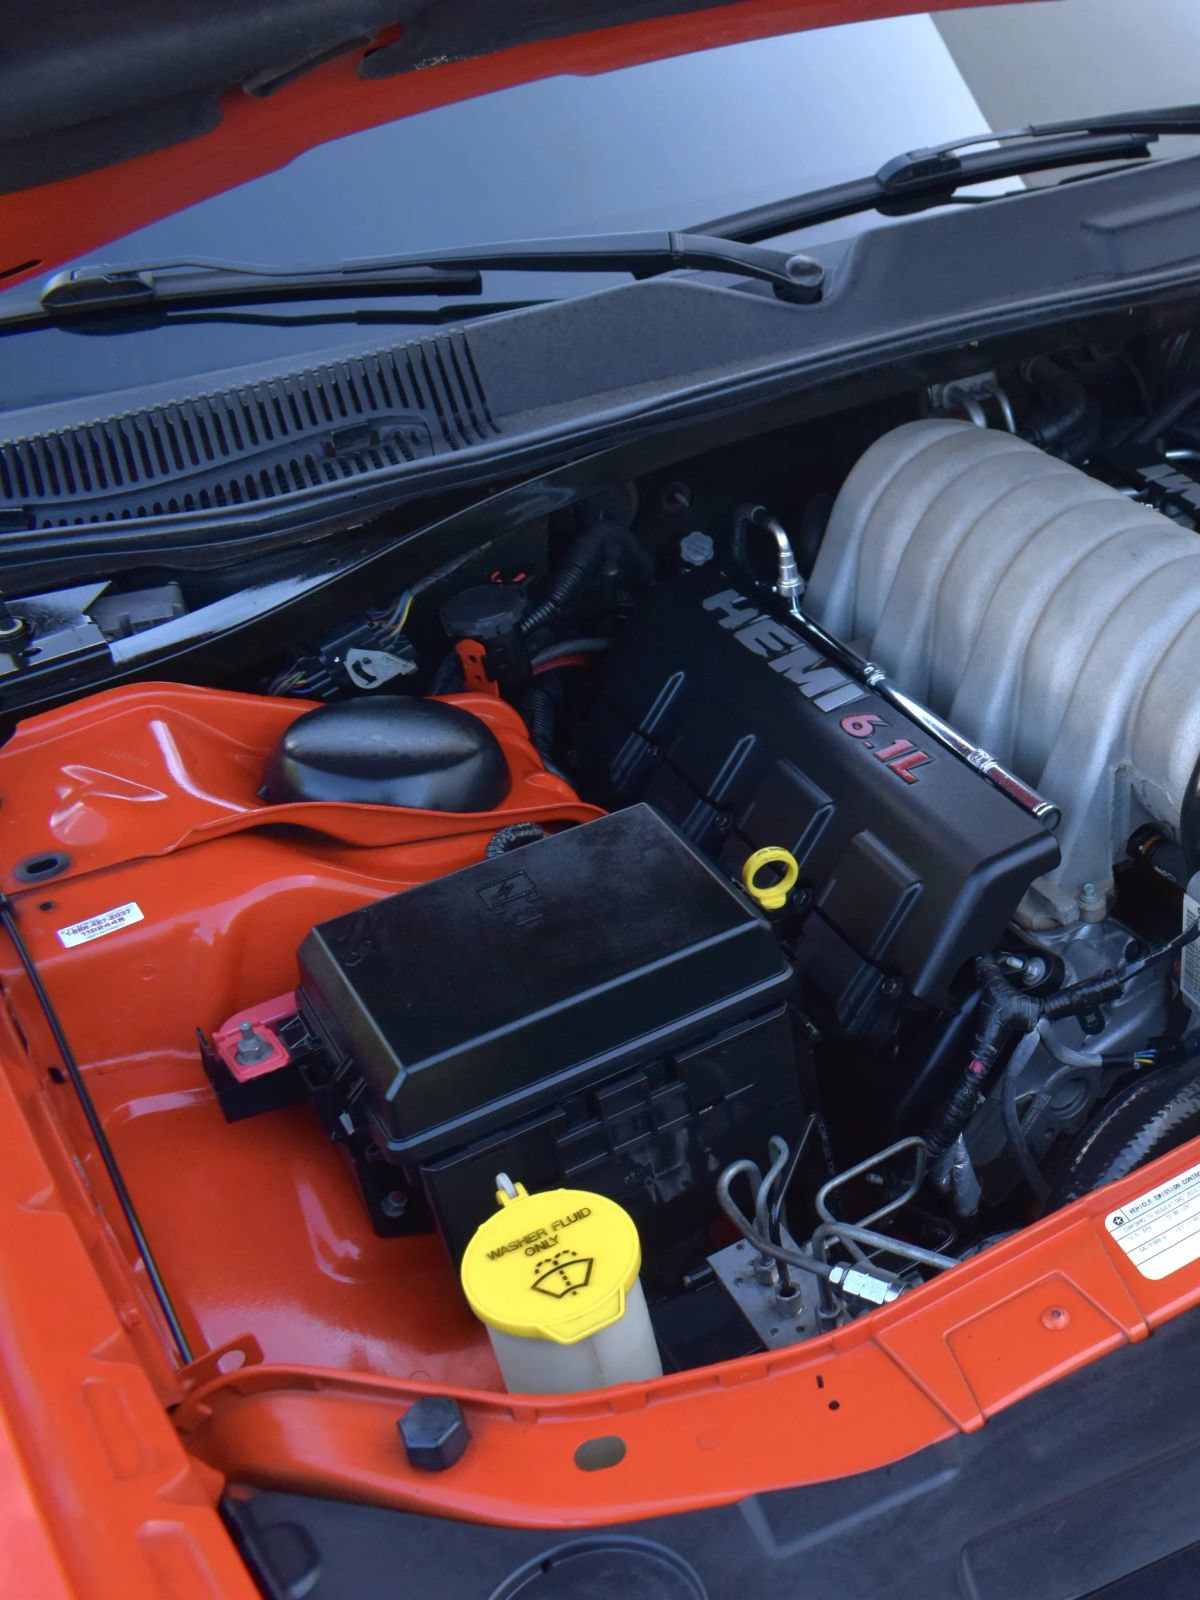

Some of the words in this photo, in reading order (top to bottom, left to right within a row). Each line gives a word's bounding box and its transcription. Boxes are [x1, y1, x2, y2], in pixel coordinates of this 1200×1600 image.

[702, 588, 870, 713] HEMI
[839, 712, 935, 785] 6.1L
[1154, 1183, 1181, 1200] EMISSION
[486, 1228, 548, 1260] WASHER
[551, 1207, 592, 1232] FLUID
[524, 1234, 559, 1257] ONLY
